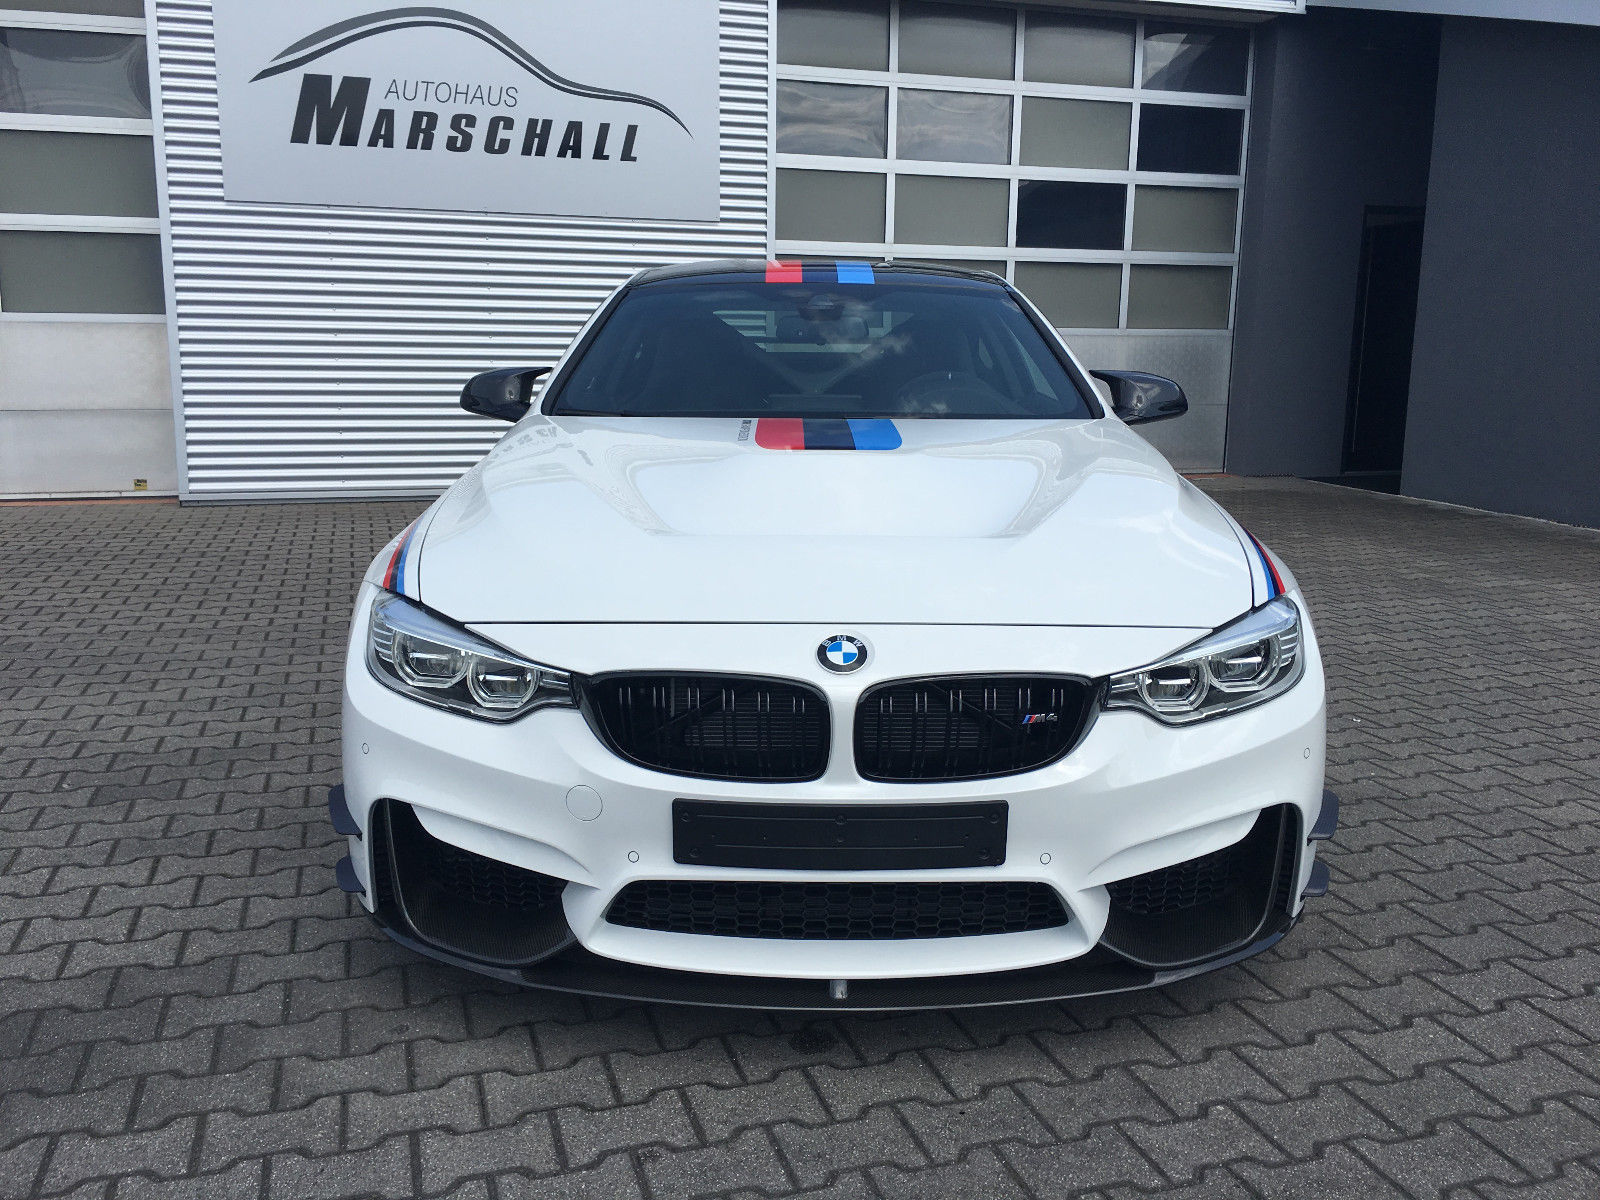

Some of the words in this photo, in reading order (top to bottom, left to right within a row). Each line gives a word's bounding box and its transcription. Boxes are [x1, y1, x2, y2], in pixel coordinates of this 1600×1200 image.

[384, 78, 519, 108] AUTOHAUS
[290, 73, 639, 163] MARSCHALL
[821, 635, 864, 647] BMW
[1029, 713, 1058, 723] M4
